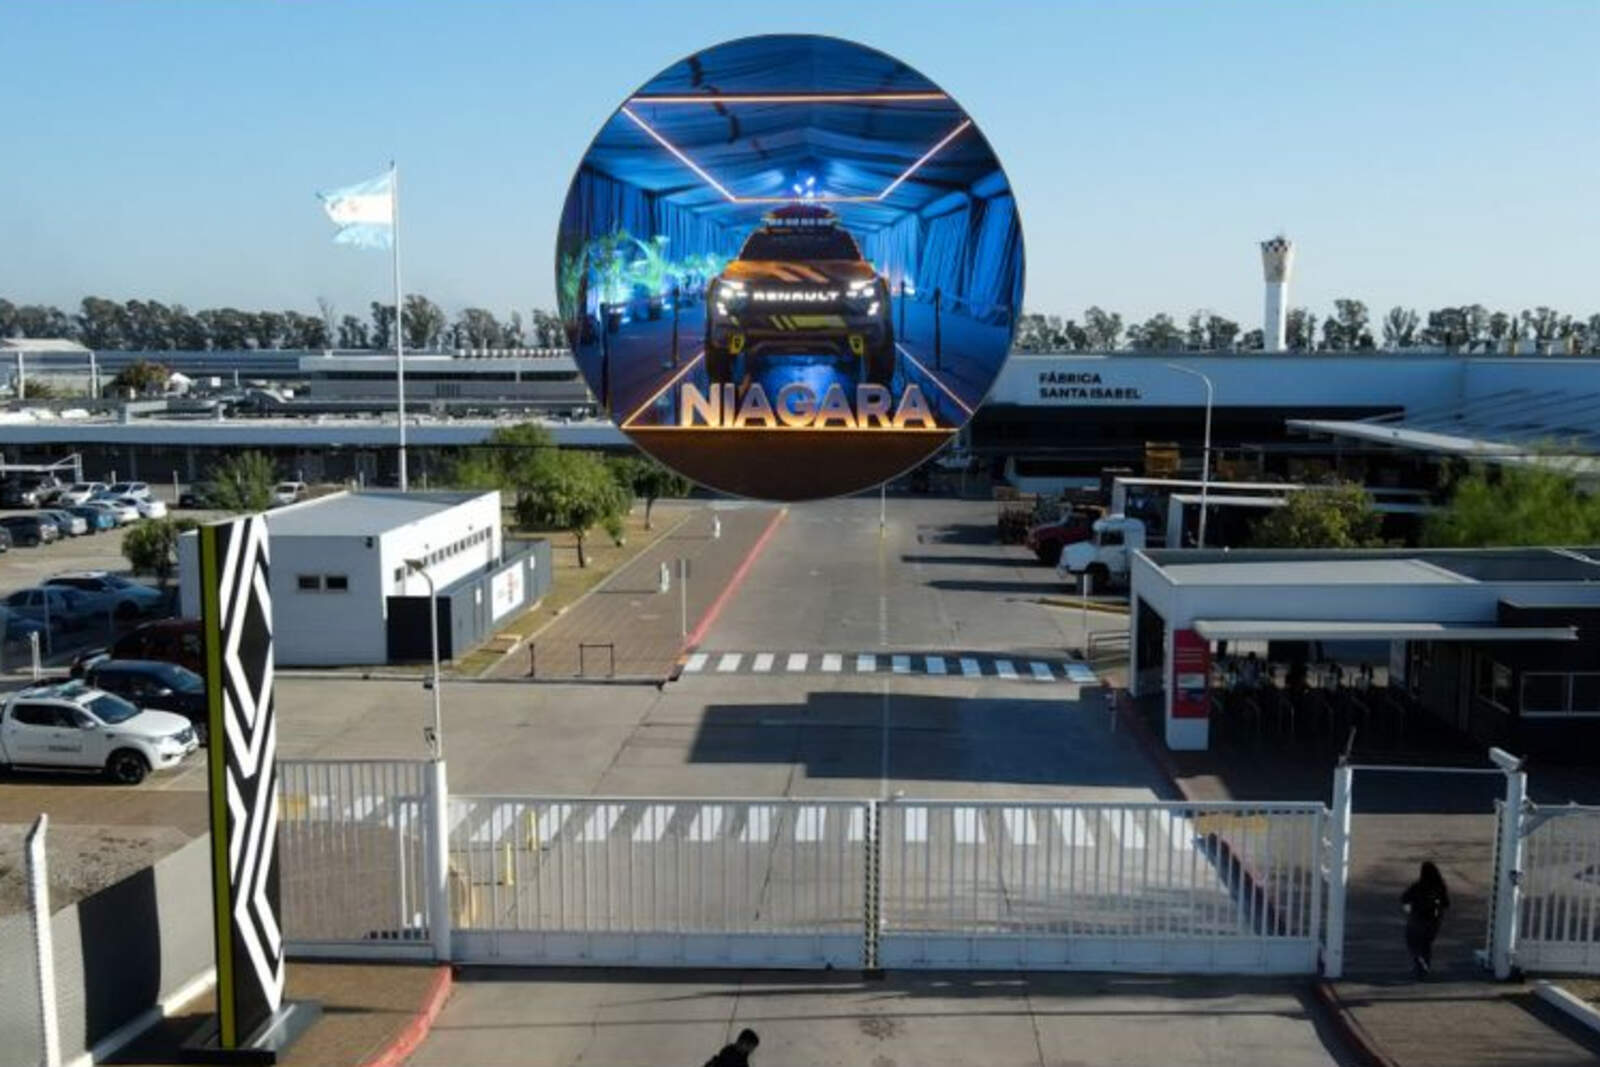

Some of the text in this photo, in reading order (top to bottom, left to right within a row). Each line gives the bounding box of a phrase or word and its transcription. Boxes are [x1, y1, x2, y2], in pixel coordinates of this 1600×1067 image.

[753, 291, 839, 301] RENAULT
[1040, 371, 1102, 384] FÁBRICA
[1040, 387, 1141, 399] SANTA ISABEL
[680, 383, 936, 428] NIAGARA
